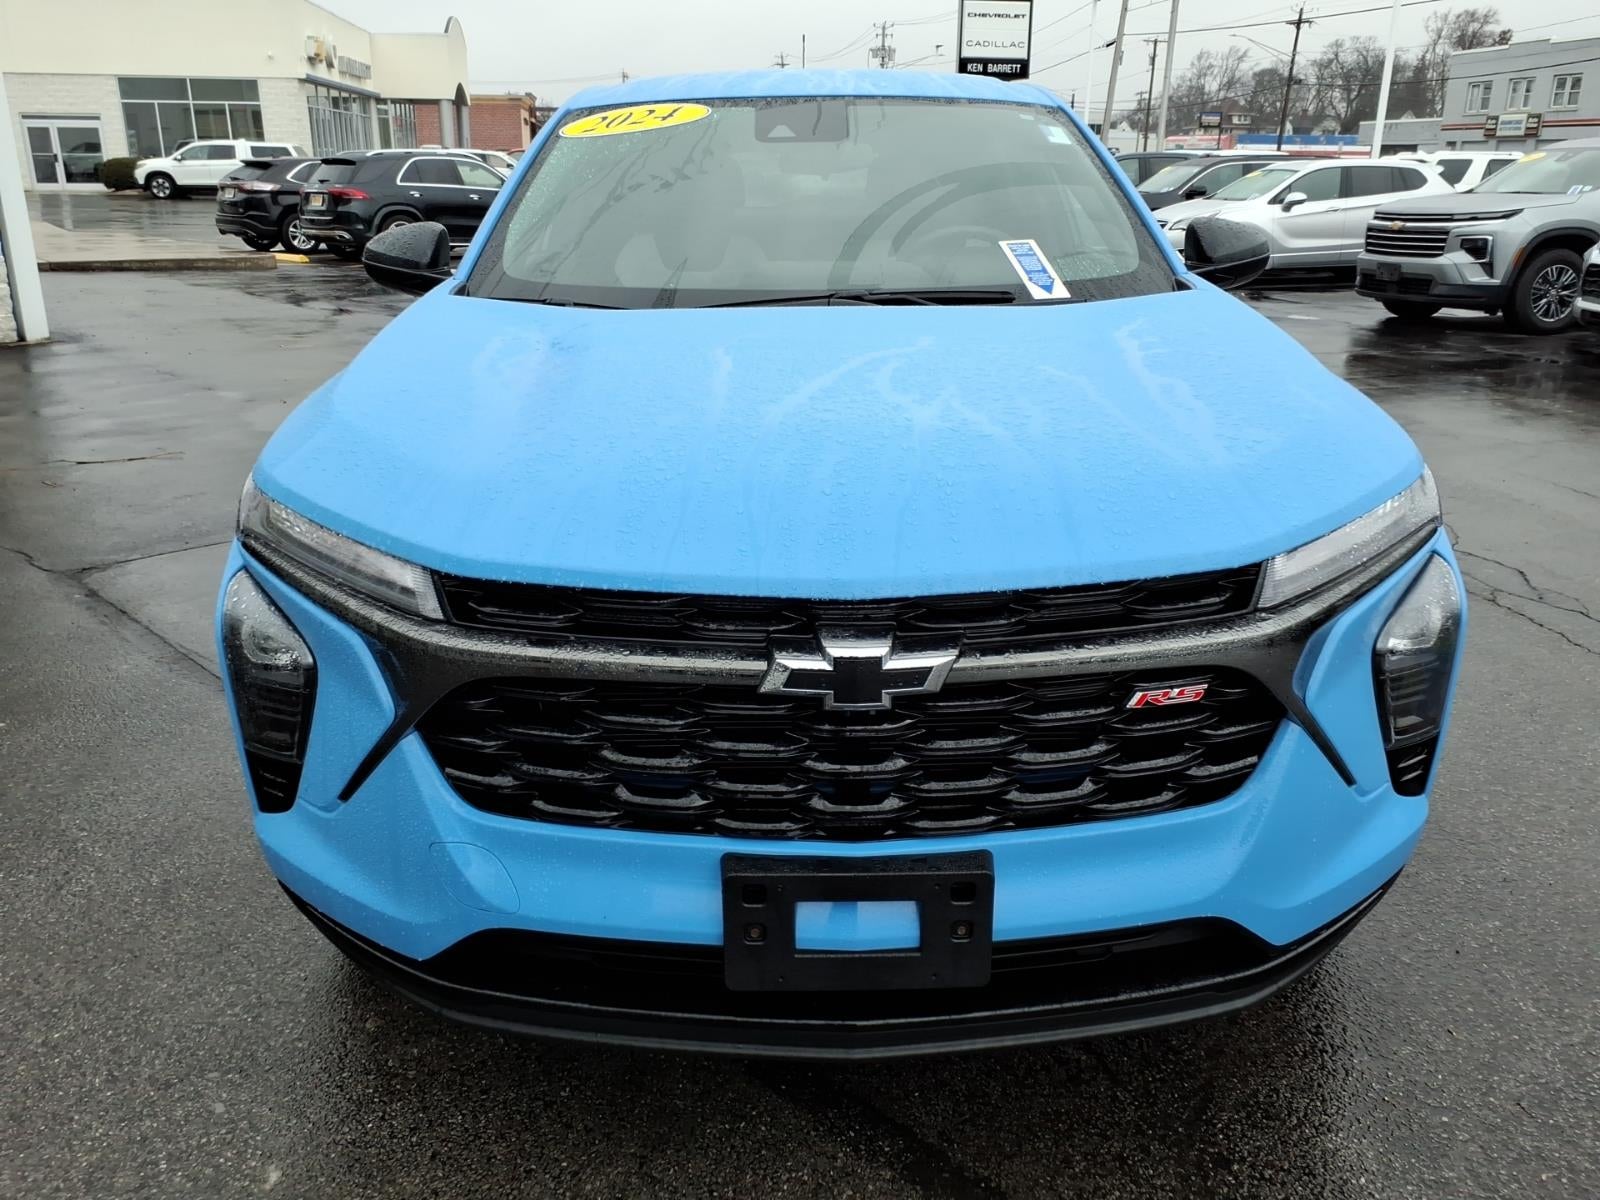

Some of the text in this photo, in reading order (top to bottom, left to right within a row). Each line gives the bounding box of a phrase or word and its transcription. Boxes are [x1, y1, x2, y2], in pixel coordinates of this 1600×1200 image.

[966, 40, 1025, 48] CADILLAC
[967, 63, 1021, 73] KEN BARRETT
[582, 106, 684, 133] 2024
[1126, 684, 1208, 708] RS
